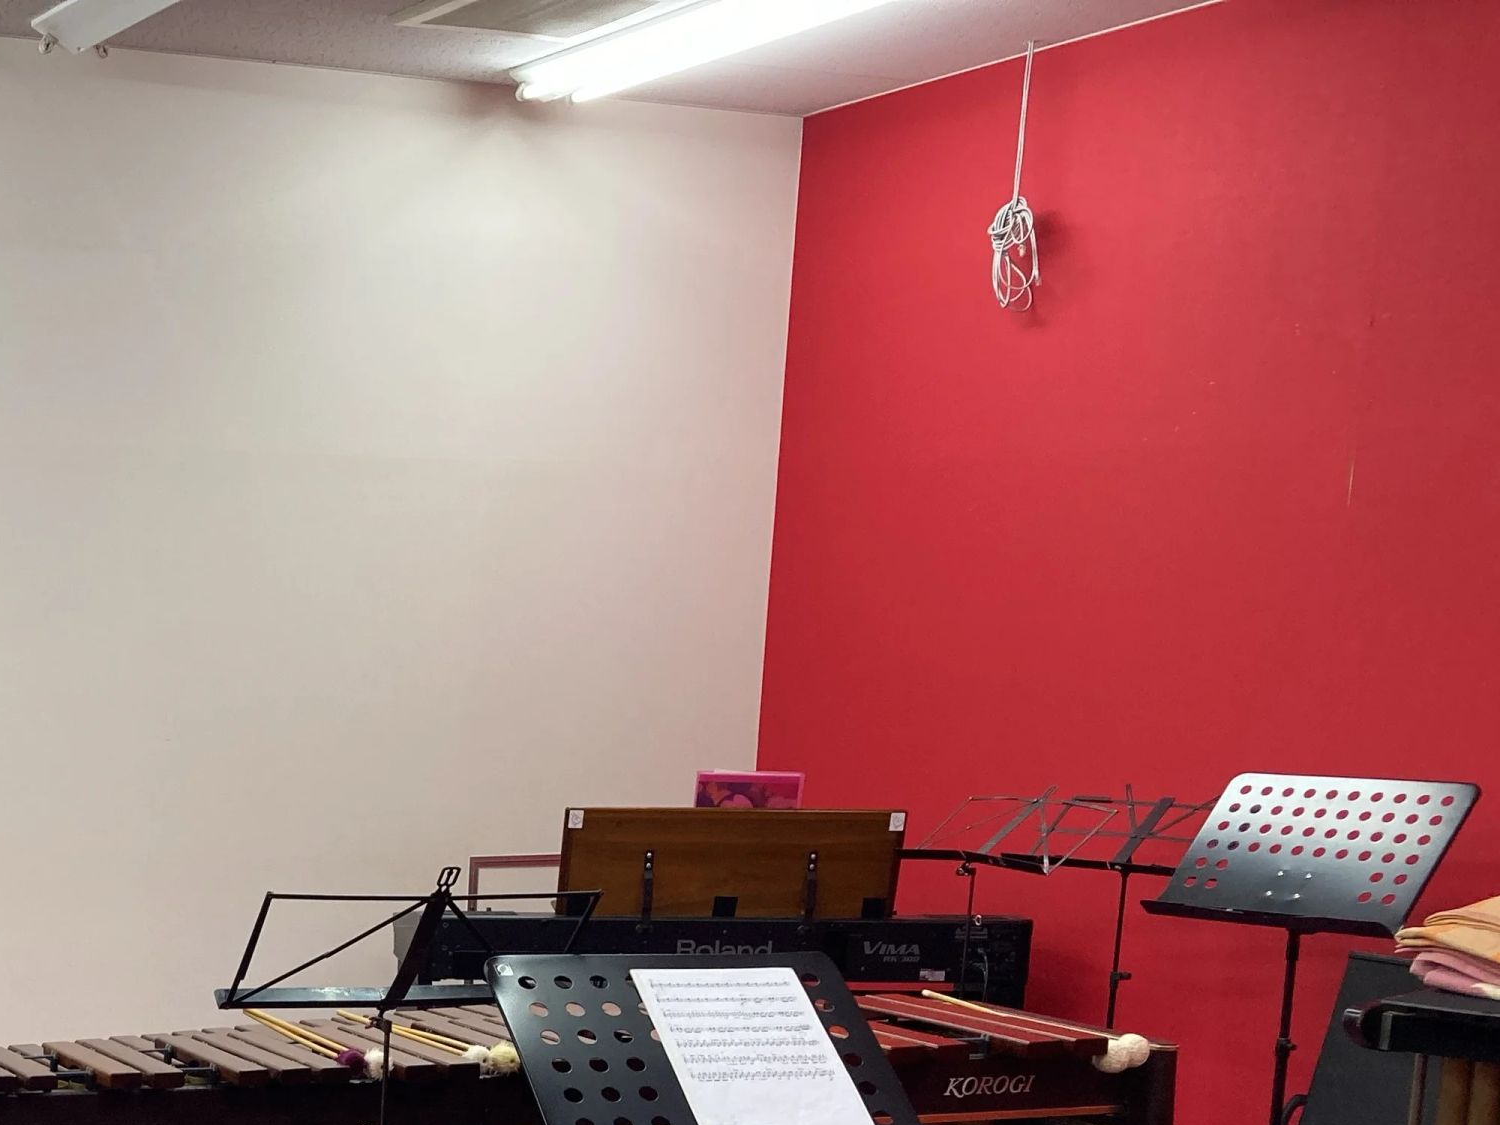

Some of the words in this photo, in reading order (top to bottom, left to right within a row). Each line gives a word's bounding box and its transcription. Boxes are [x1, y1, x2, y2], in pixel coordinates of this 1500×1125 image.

[676, 939, 773, 955] Roland
[863, 941, 920, 955] VIMA
[943, 1074, 1035, 1098] KOROGI
